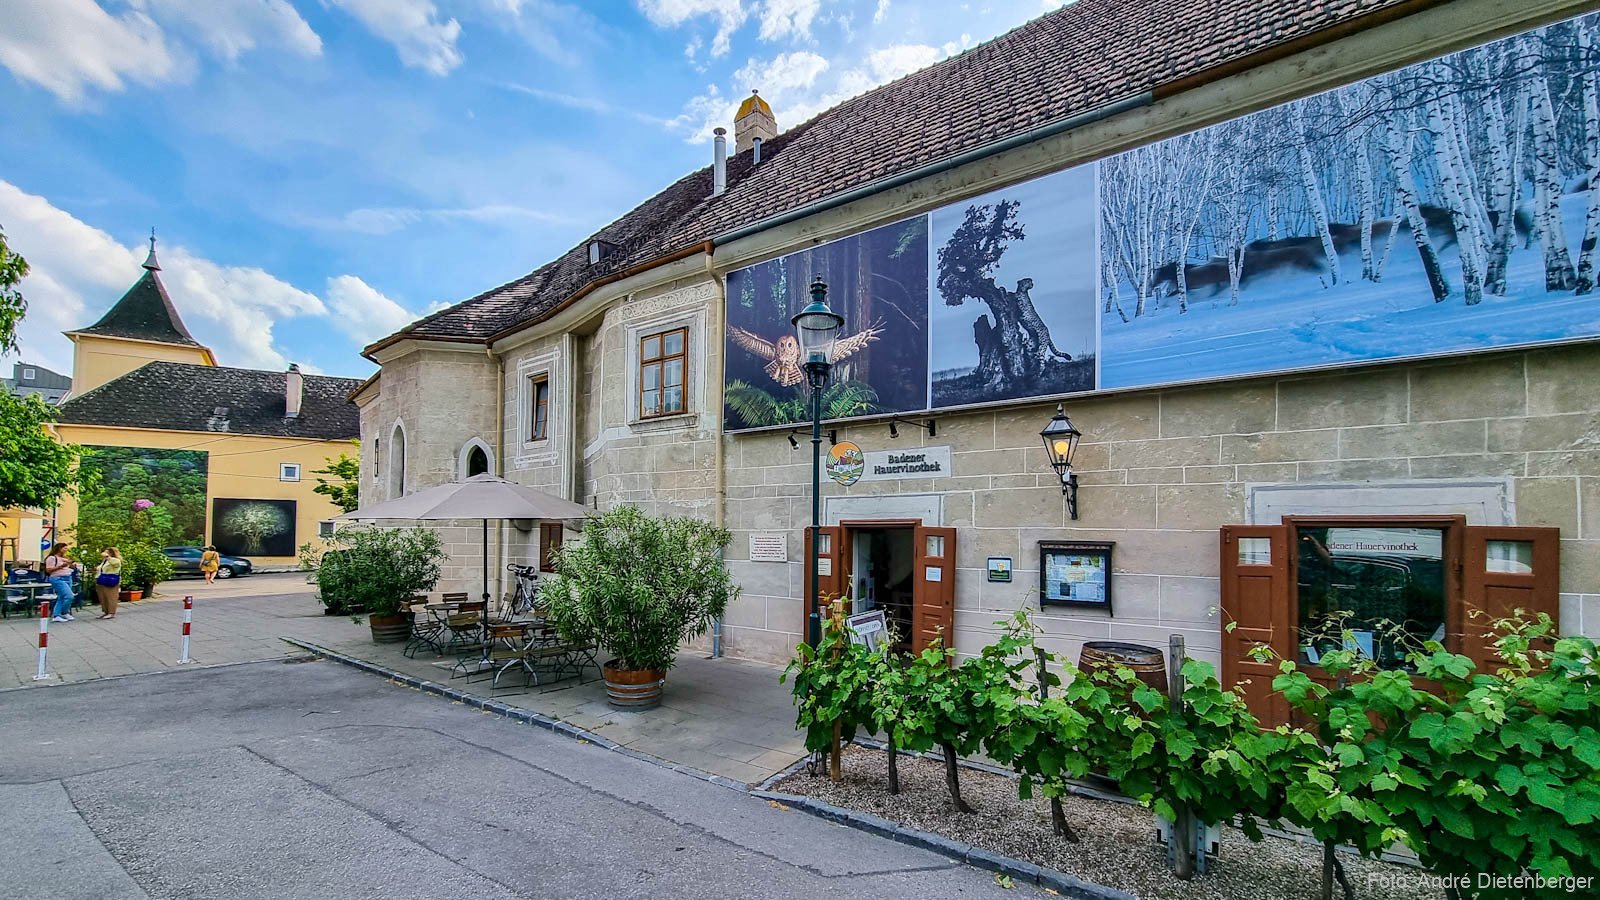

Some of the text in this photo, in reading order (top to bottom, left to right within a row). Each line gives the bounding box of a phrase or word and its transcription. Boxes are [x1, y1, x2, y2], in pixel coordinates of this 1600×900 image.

[888, 453, 925, 464] Badener
[874, 462, 941, 474] Hauervinothek
[1327, 542, 1418, 552] adener Hauervinothek
